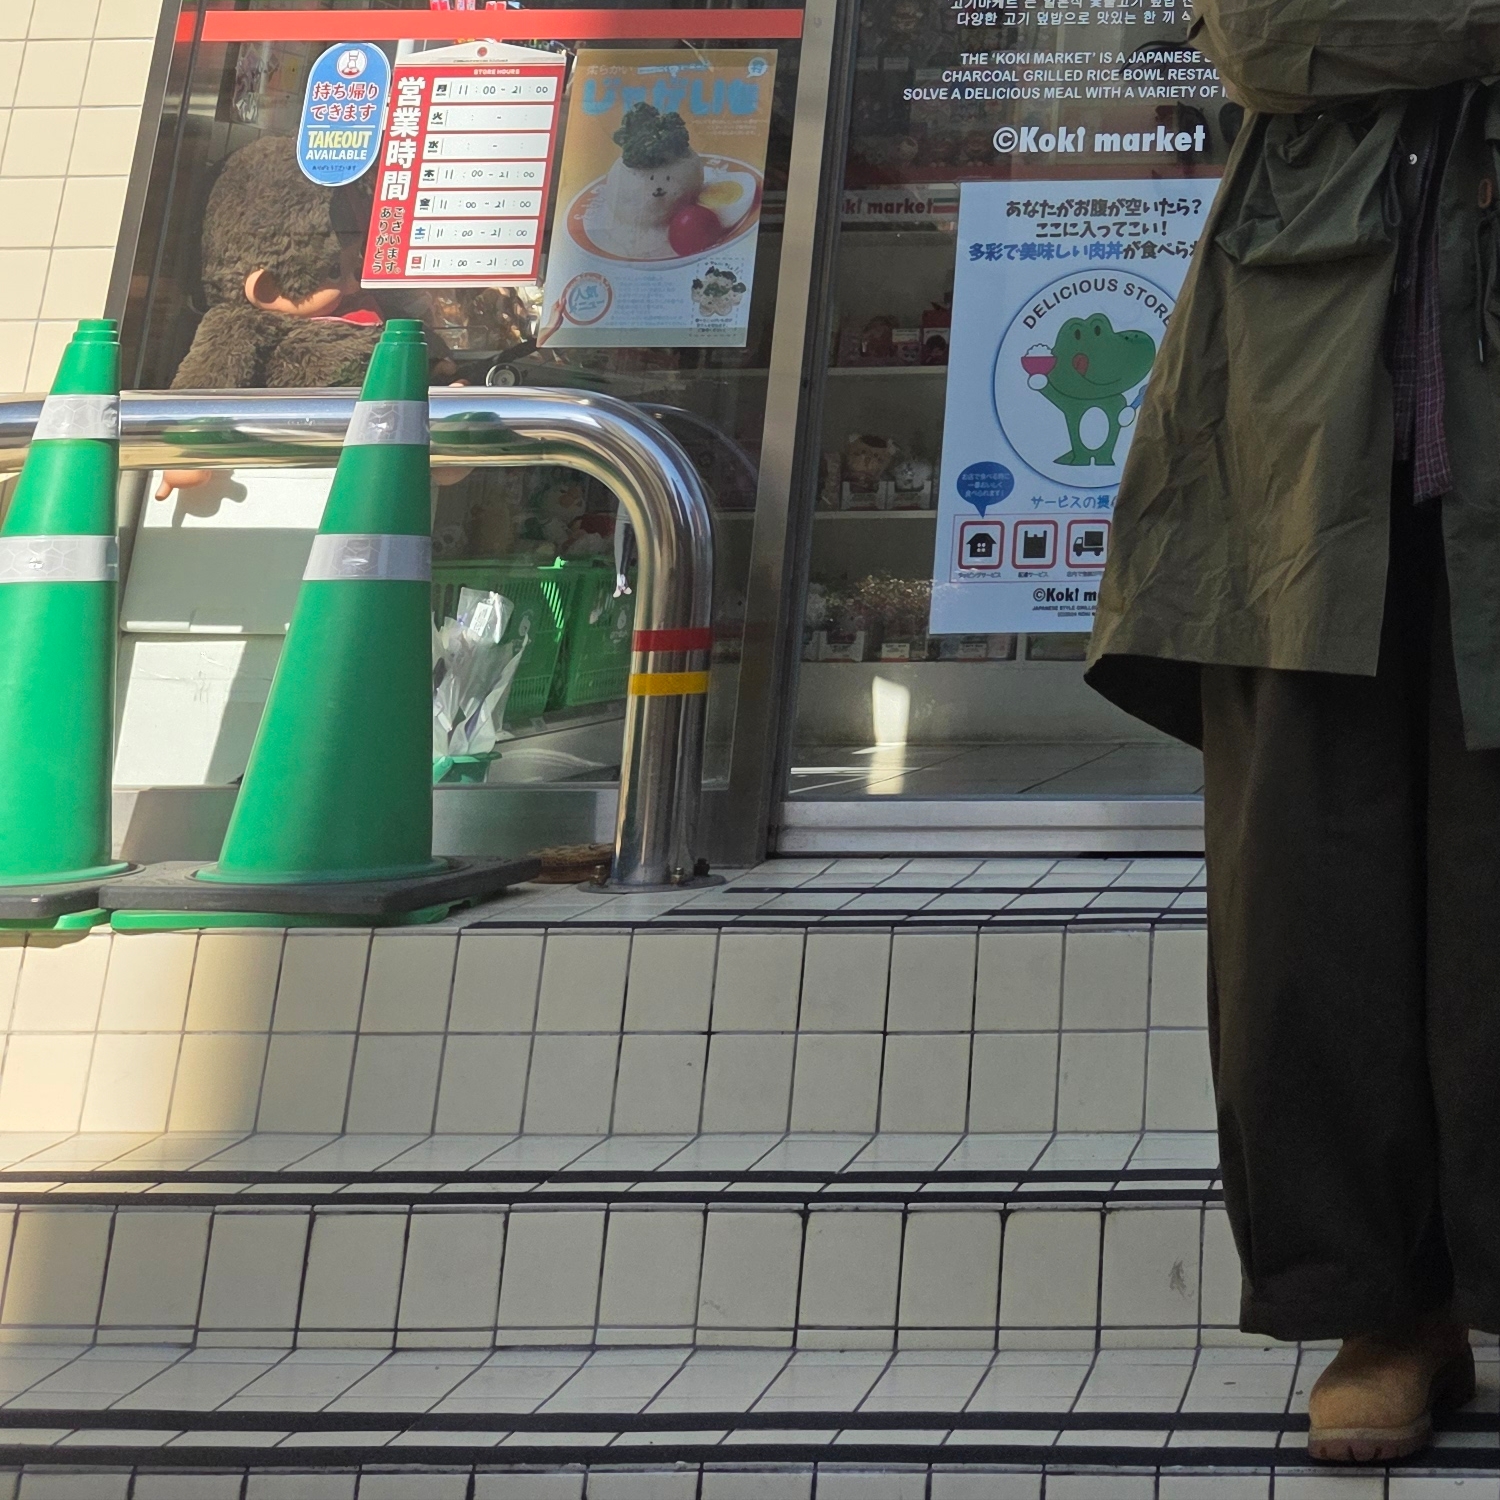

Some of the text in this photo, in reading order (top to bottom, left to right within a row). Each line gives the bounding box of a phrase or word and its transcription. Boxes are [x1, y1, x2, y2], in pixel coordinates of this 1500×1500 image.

[956, 10, 1176, 26] 다양한 고기 덮밥으로 맛있는 한 끼
[960, 52, 989, 66] THE
[1099, 51, 1113, 65] IS
[1115, 51, 1127, 65] A
[1128, 50, 1203, 65] JAPANESE
[473, 68, 520, 76] STORE HOURS
[941, 68, 1165, 83] CHARCOAL GRILLED RICE BOWL
[313, 82, 379, 100] 持ち帰り
[436, 84, 448, 93] 月
[902, 86, 1220, 101] SOLVE A DELICIOUS MEAL WITH A VARIETY OF
[311, 103, 377, 120] できます
[431, 111, 443, 121] 火
[307, 130, 373, 149] TAKEOUT
[379, 75, 426, 202] 営業時間
[427, 140, 439, 149] 水
[1094, 125, 1206, 153] market
[306, 149, 368, 160] AVAILABLE
[423, 169, 436, 178] 木
[419, 197, 431, 207] 金
[867, 197, 935, 215] market
[1005, 198, 1203, 218] あなたがお腹が空いたら?
[414, 226, 426, 236] 土
[1035, 220, 1168, 239] ここに入ってこい!
[371, 206, 393, 274] ありがとう
[385, 206, 406, 275] ございます。
[411, 255, 423, 265] 日
[1022, 277, 1119, 330] DELICIOUS
